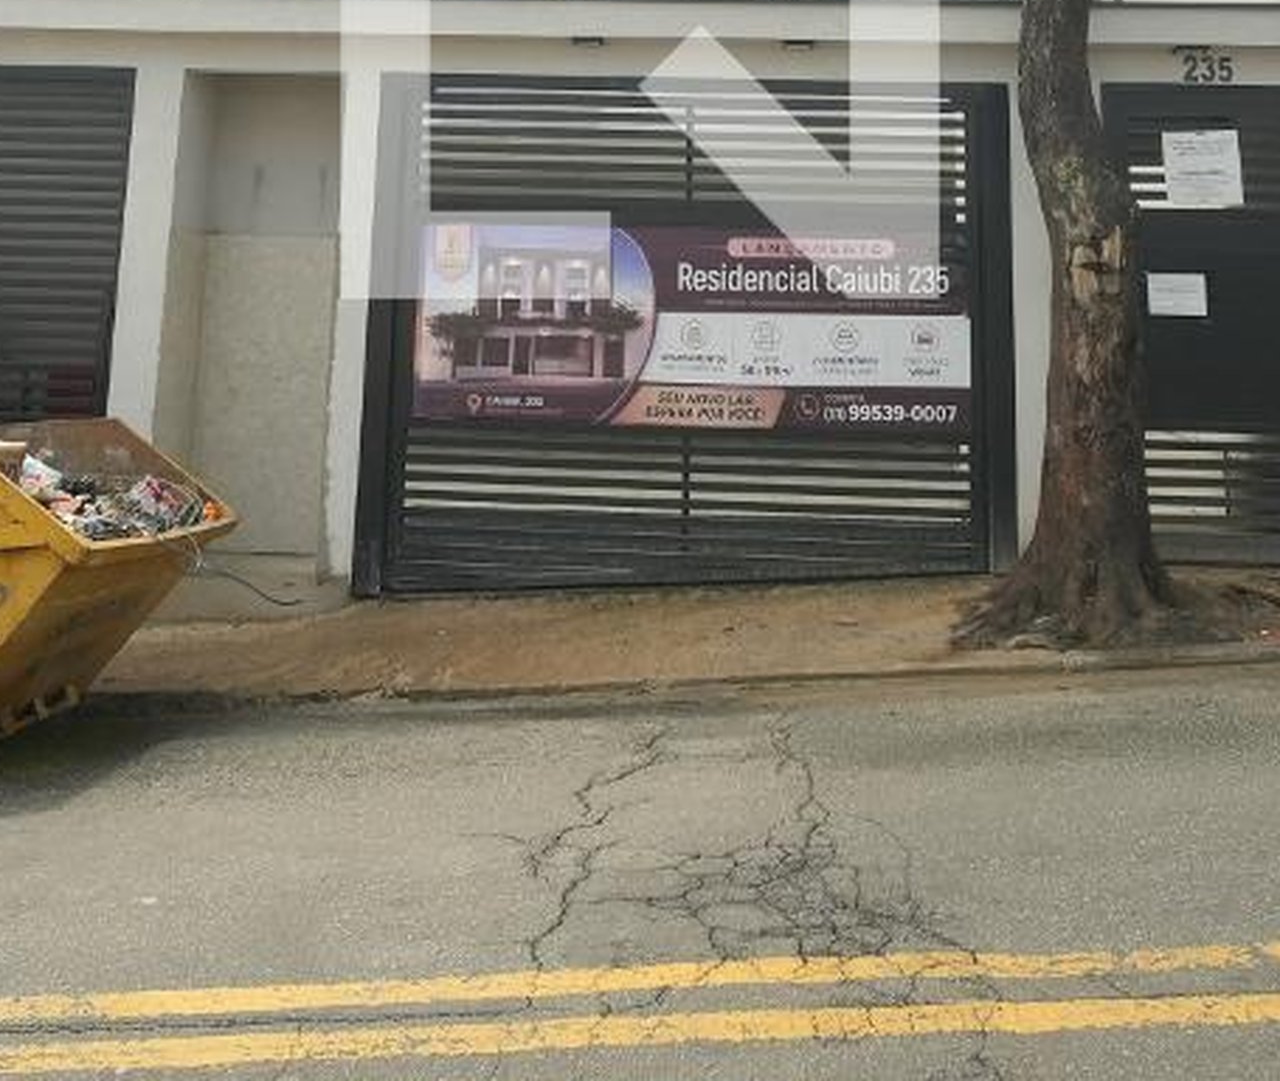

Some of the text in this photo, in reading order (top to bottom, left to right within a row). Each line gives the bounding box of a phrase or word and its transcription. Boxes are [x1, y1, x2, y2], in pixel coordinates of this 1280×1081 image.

[1183, 55, 1234, 82] 235
[677, 262, 949, 295] Residencial Caiubi 235
[848, 404, 958, 423] 99539-0007
